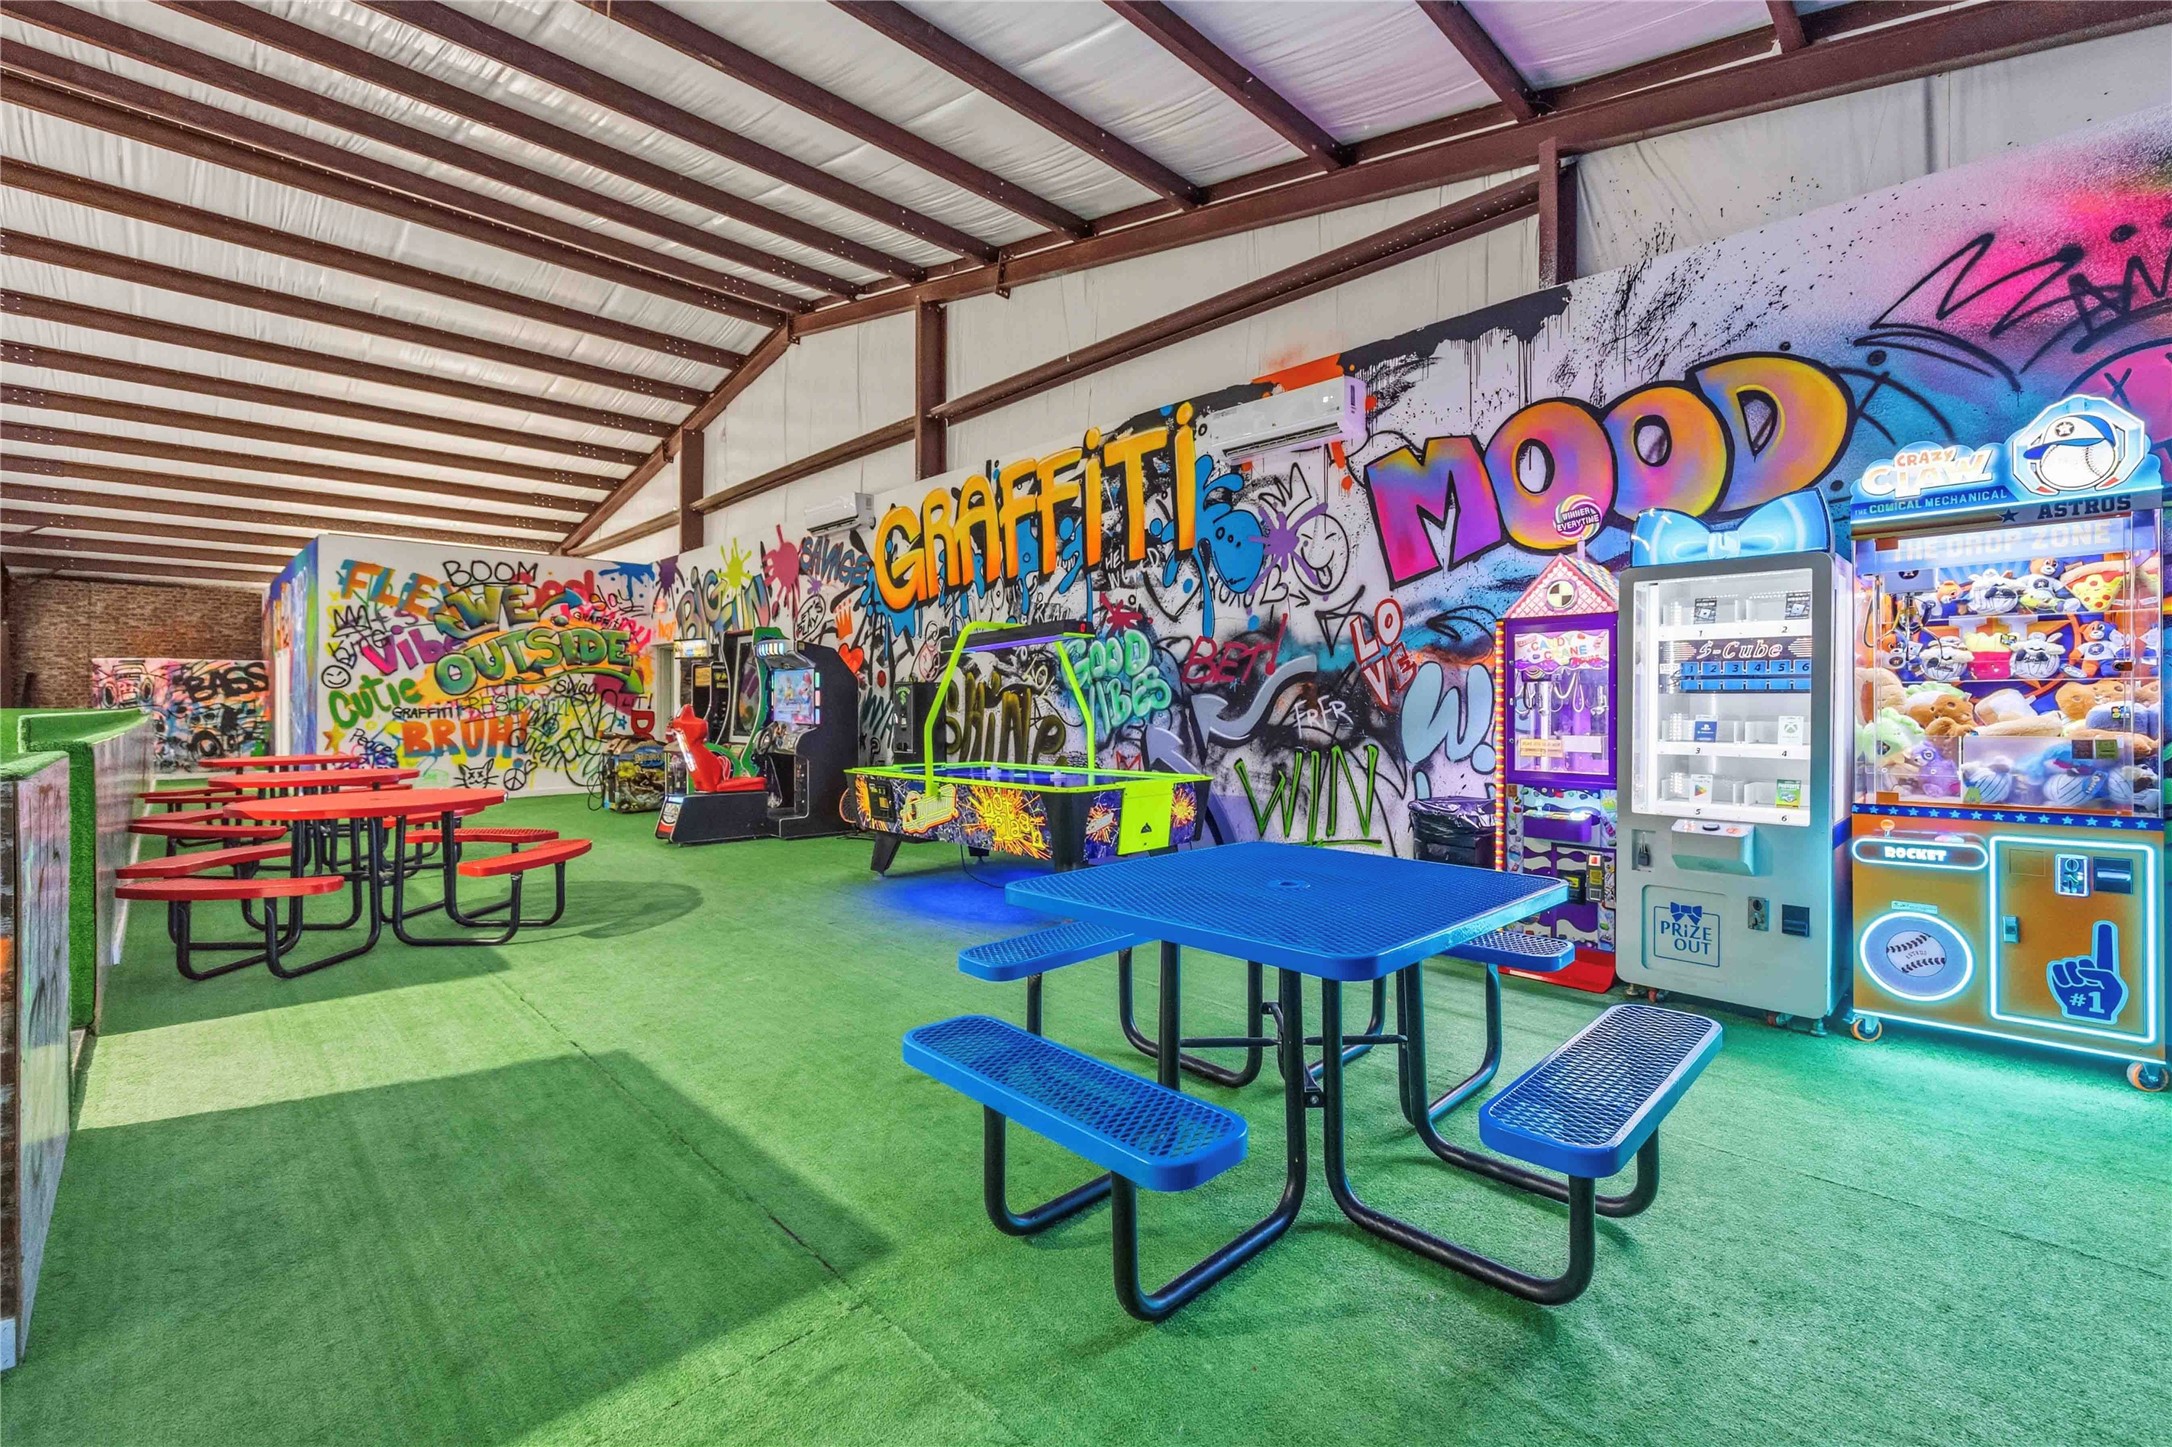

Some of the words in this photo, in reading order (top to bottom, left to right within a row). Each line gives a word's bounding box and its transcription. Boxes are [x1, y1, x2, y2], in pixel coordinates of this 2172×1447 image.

[1365, 352, 1854, 588] MOOD
[1869, 502, 1922, 514] COMICAL
[1925, 489, 2008, 507] MECHANICAL
[2037, 495, 2132, 519] ASTROS
[1557, 514, 1600, 532] EVERYTIME
[1561, 508, 1591, 521] WINNER
[1947, 530, 2021, 558] DROP
[2030, 520, 2111, 550] ZONE
[443, 560, 538, 586] BOOM
[443, 584, 540, 630] WE
[797, 615, 819, 638] PLAY
[1061, 629, 1153, 689] GOOD
[1181, 613, 1288, 684] BET!
[1710, 664, 1717, 672] 2
[1732, 664, 1739, 672] 3
[1754, 663, 1761, 672] 4
[1777, 663, 1785, 671] 5
[1802, 662, 1809, 671] 6
[1234, 744, 1378, 844] WIN
[1884, 846, 1947, 861] ROCKET
[1674, 938, 1711, 956] OUT
[2069, 990, 2105, 1014] #1
